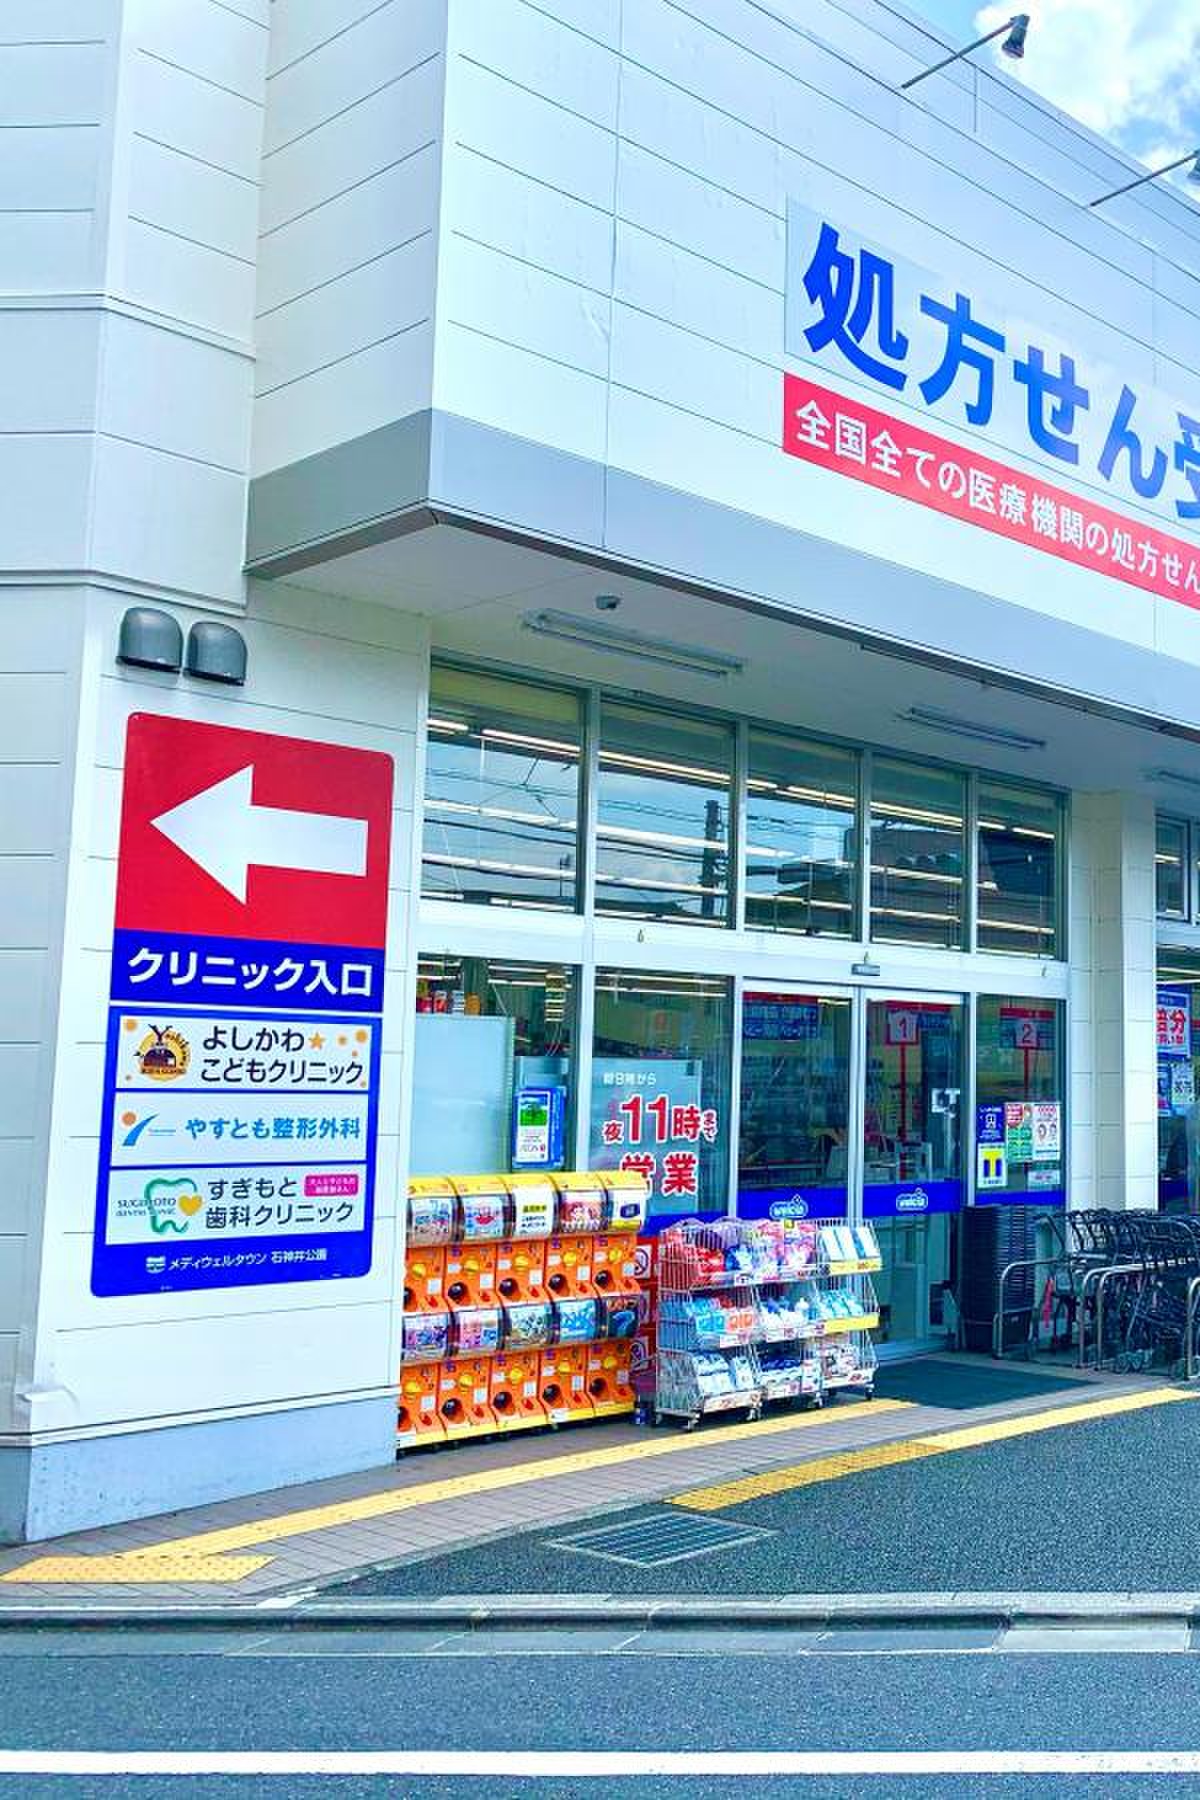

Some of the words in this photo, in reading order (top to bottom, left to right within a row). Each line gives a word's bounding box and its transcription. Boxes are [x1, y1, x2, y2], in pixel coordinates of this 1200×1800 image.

[128, 947, 372, 997] クリニック入口
[202, 1025, 305, 1052] よしかわ
[201, 1057, 363, 1085] こどもクリニック
[186, 1117, 361, 1140] やすとも整形外科
[208, 1177, 297, 1200] すぎもと
[206, 1201, 353, 1229] 歯科クリニック
[169, 1252, 267, 1271] メディウェルタウン
[271, 1248, 327, 1264] 石神井公園
